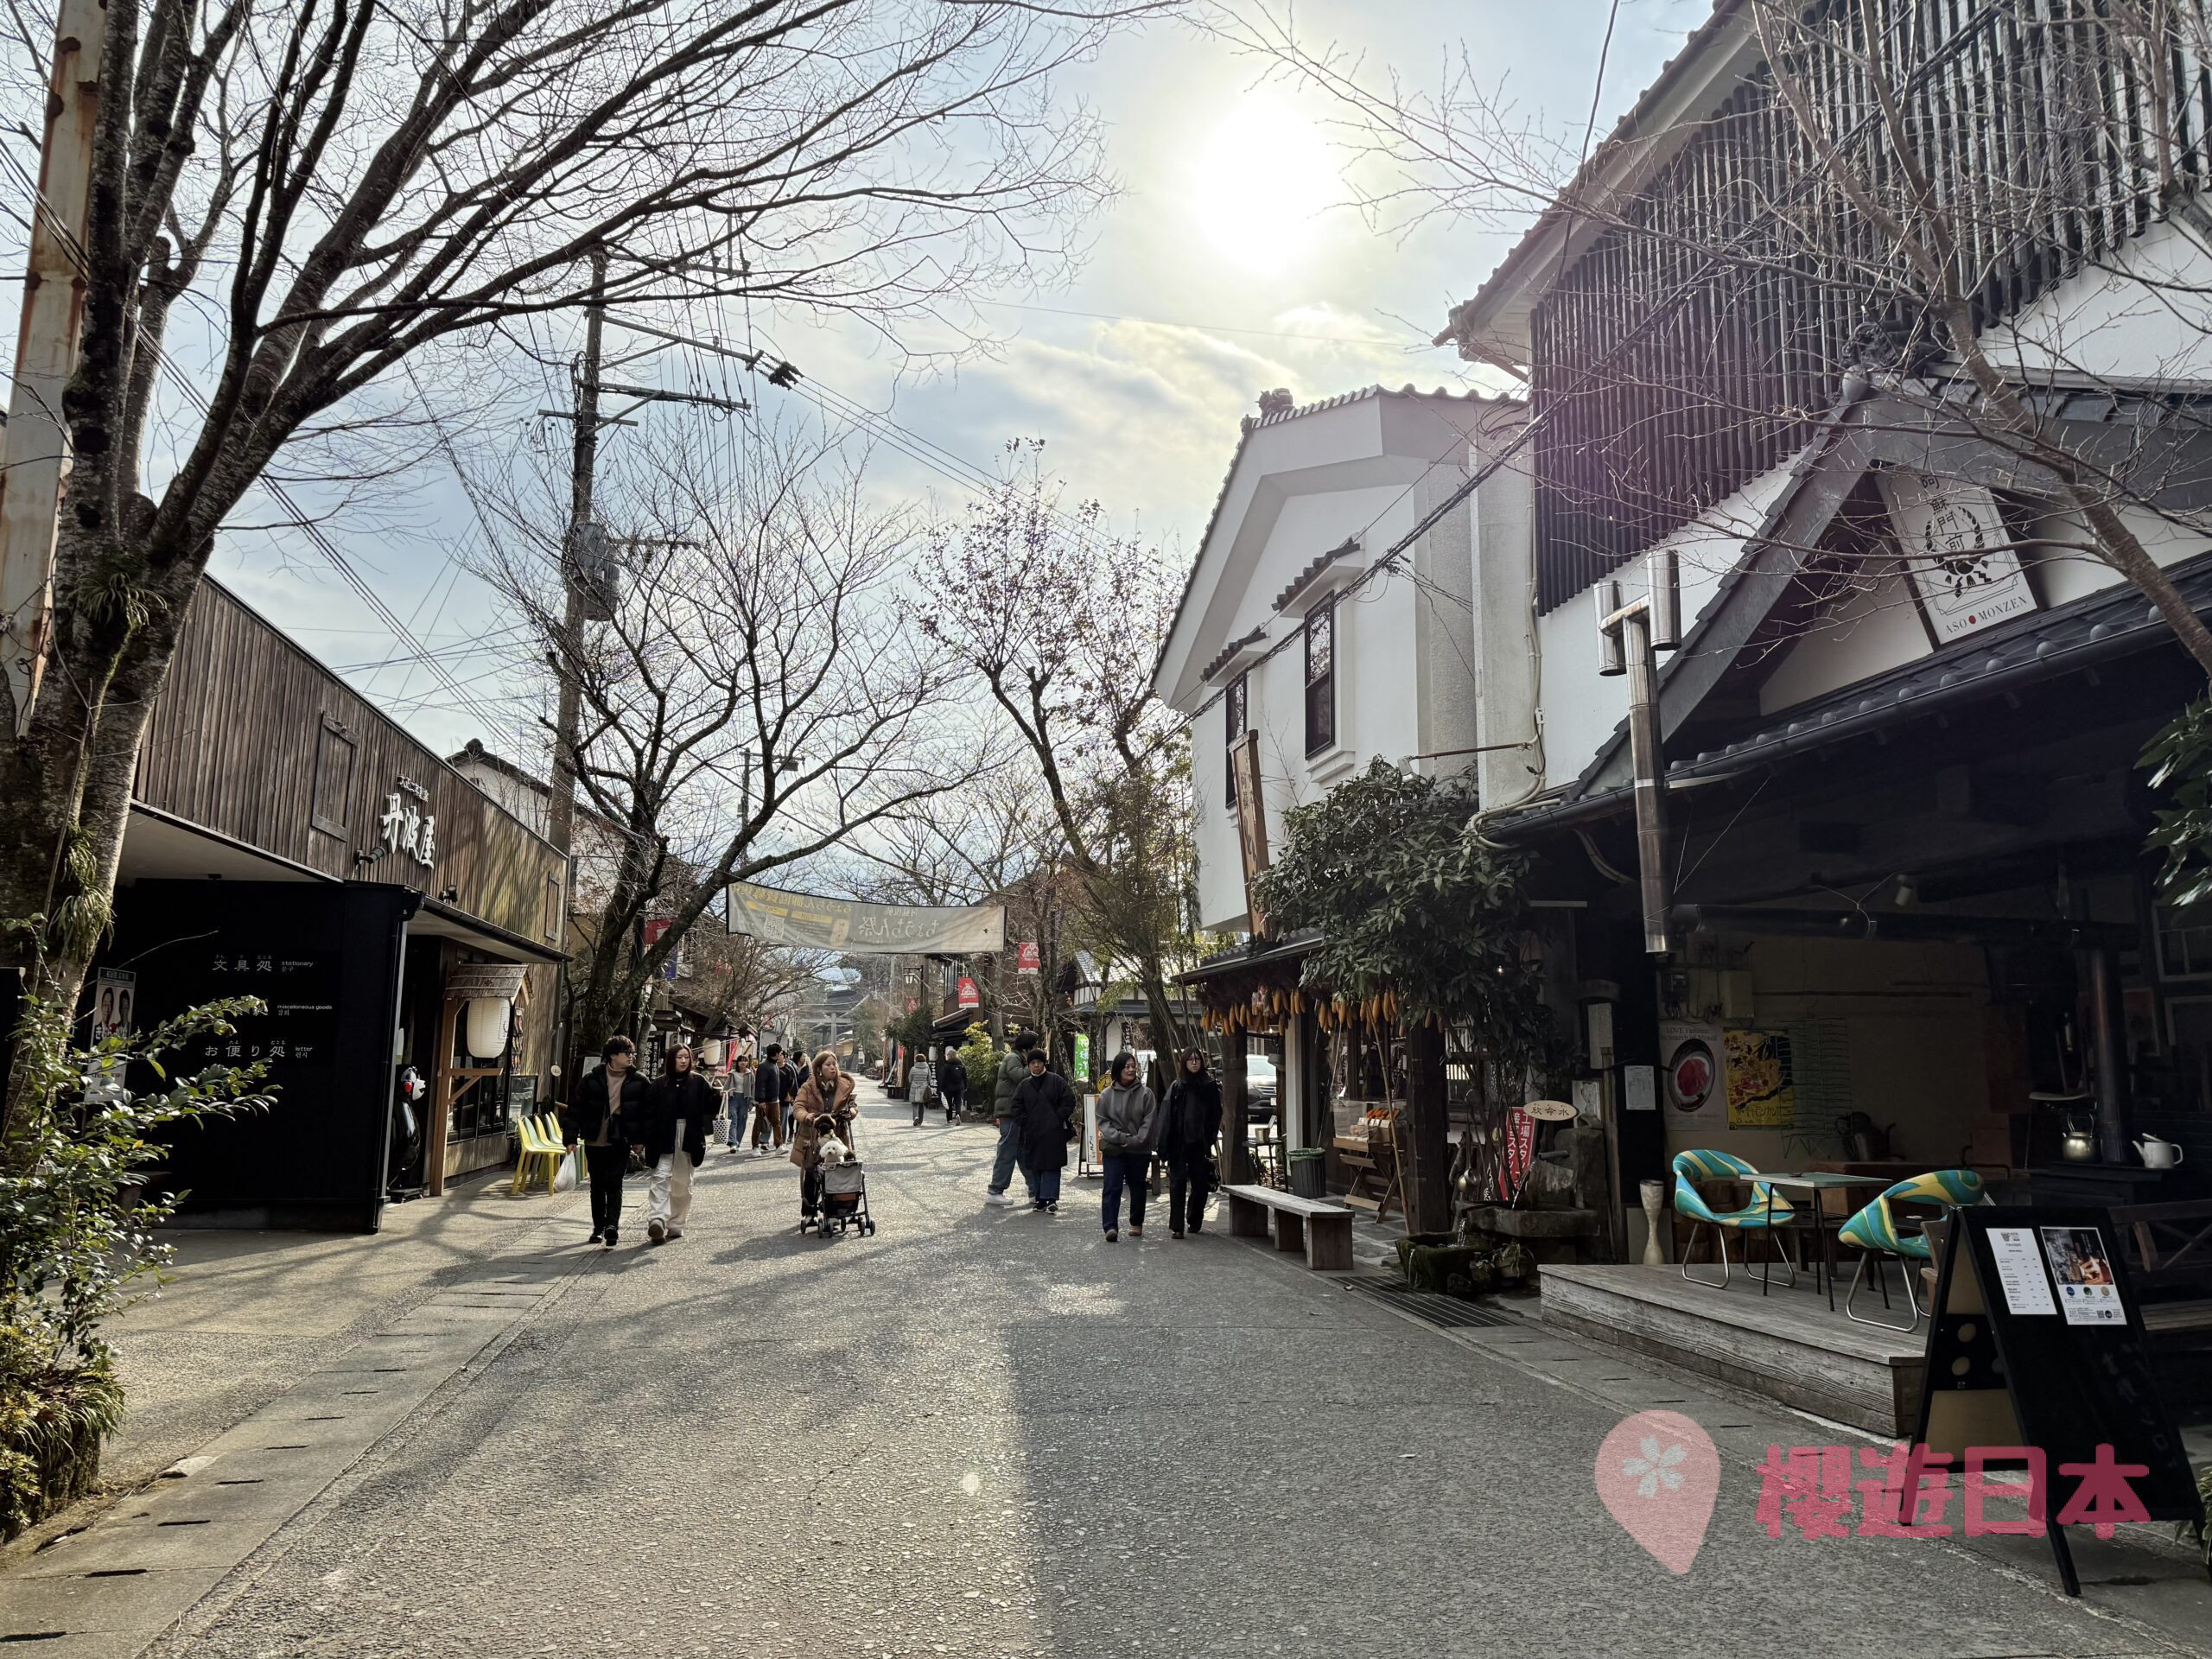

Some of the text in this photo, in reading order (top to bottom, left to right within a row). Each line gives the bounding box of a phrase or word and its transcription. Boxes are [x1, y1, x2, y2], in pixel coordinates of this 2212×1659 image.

[1945, 594, 2029, 635] ASO MONZEN
[379, 792, 435, 870] 丹波屋
[212, 959, 272, 972] 文具処
[205, 1045, 286, 1058] お便り処
